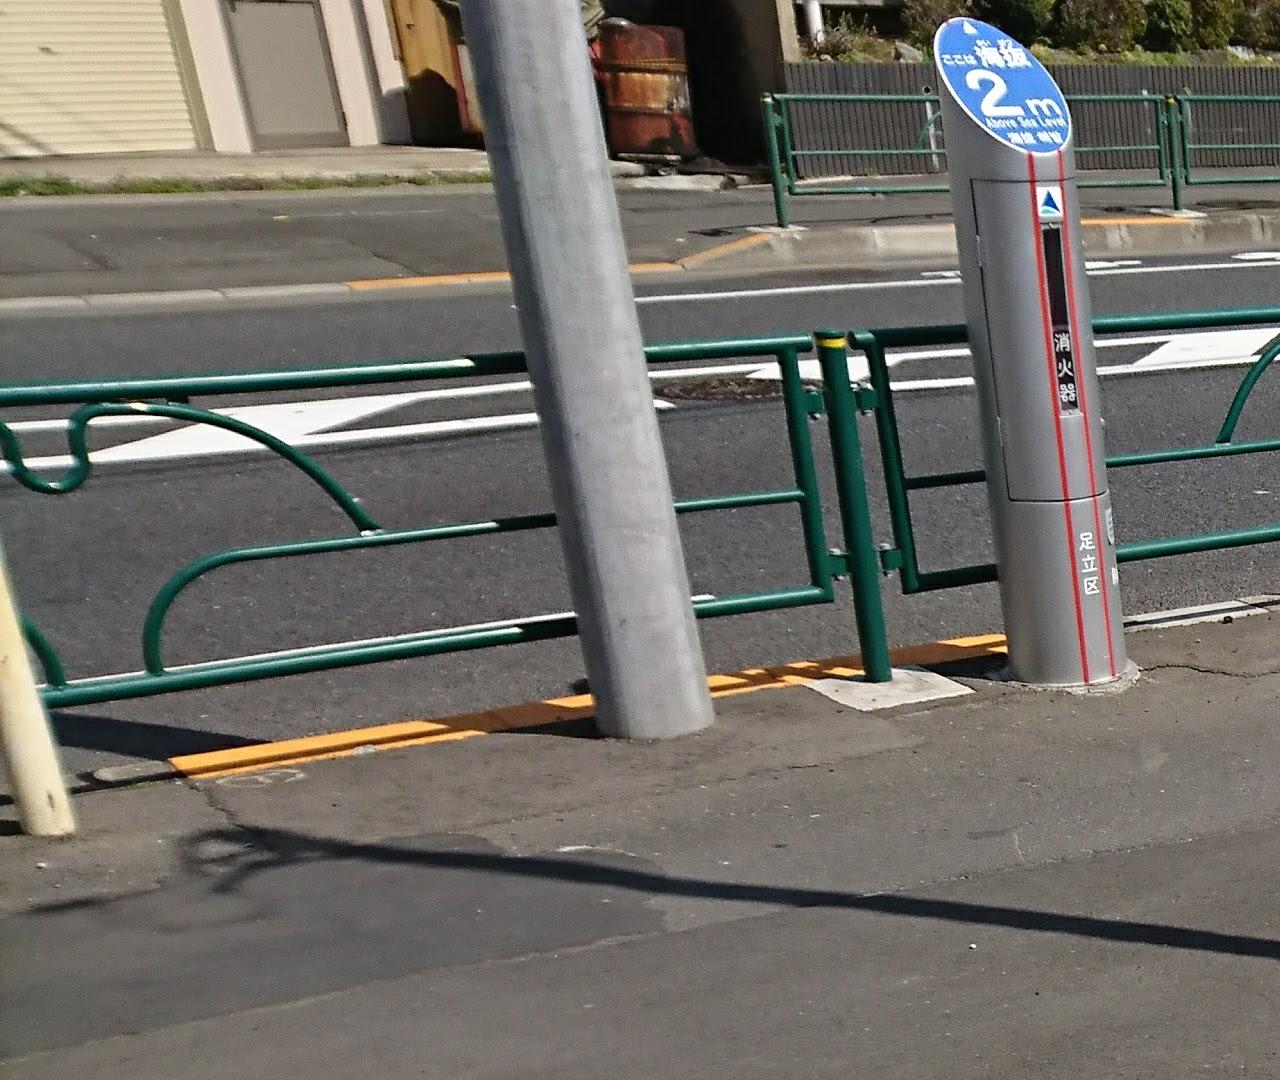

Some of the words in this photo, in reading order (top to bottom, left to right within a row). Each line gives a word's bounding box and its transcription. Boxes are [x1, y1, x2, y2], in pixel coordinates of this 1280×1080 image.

[985, 116, 1018, 129] Above
[1017, 116, 1039, 129] Sea
[1036, 115, 1068, 128] Level
[1055, 332, 1076, 402] 消火器
[1079, 532, 1100, 595] 足立区
